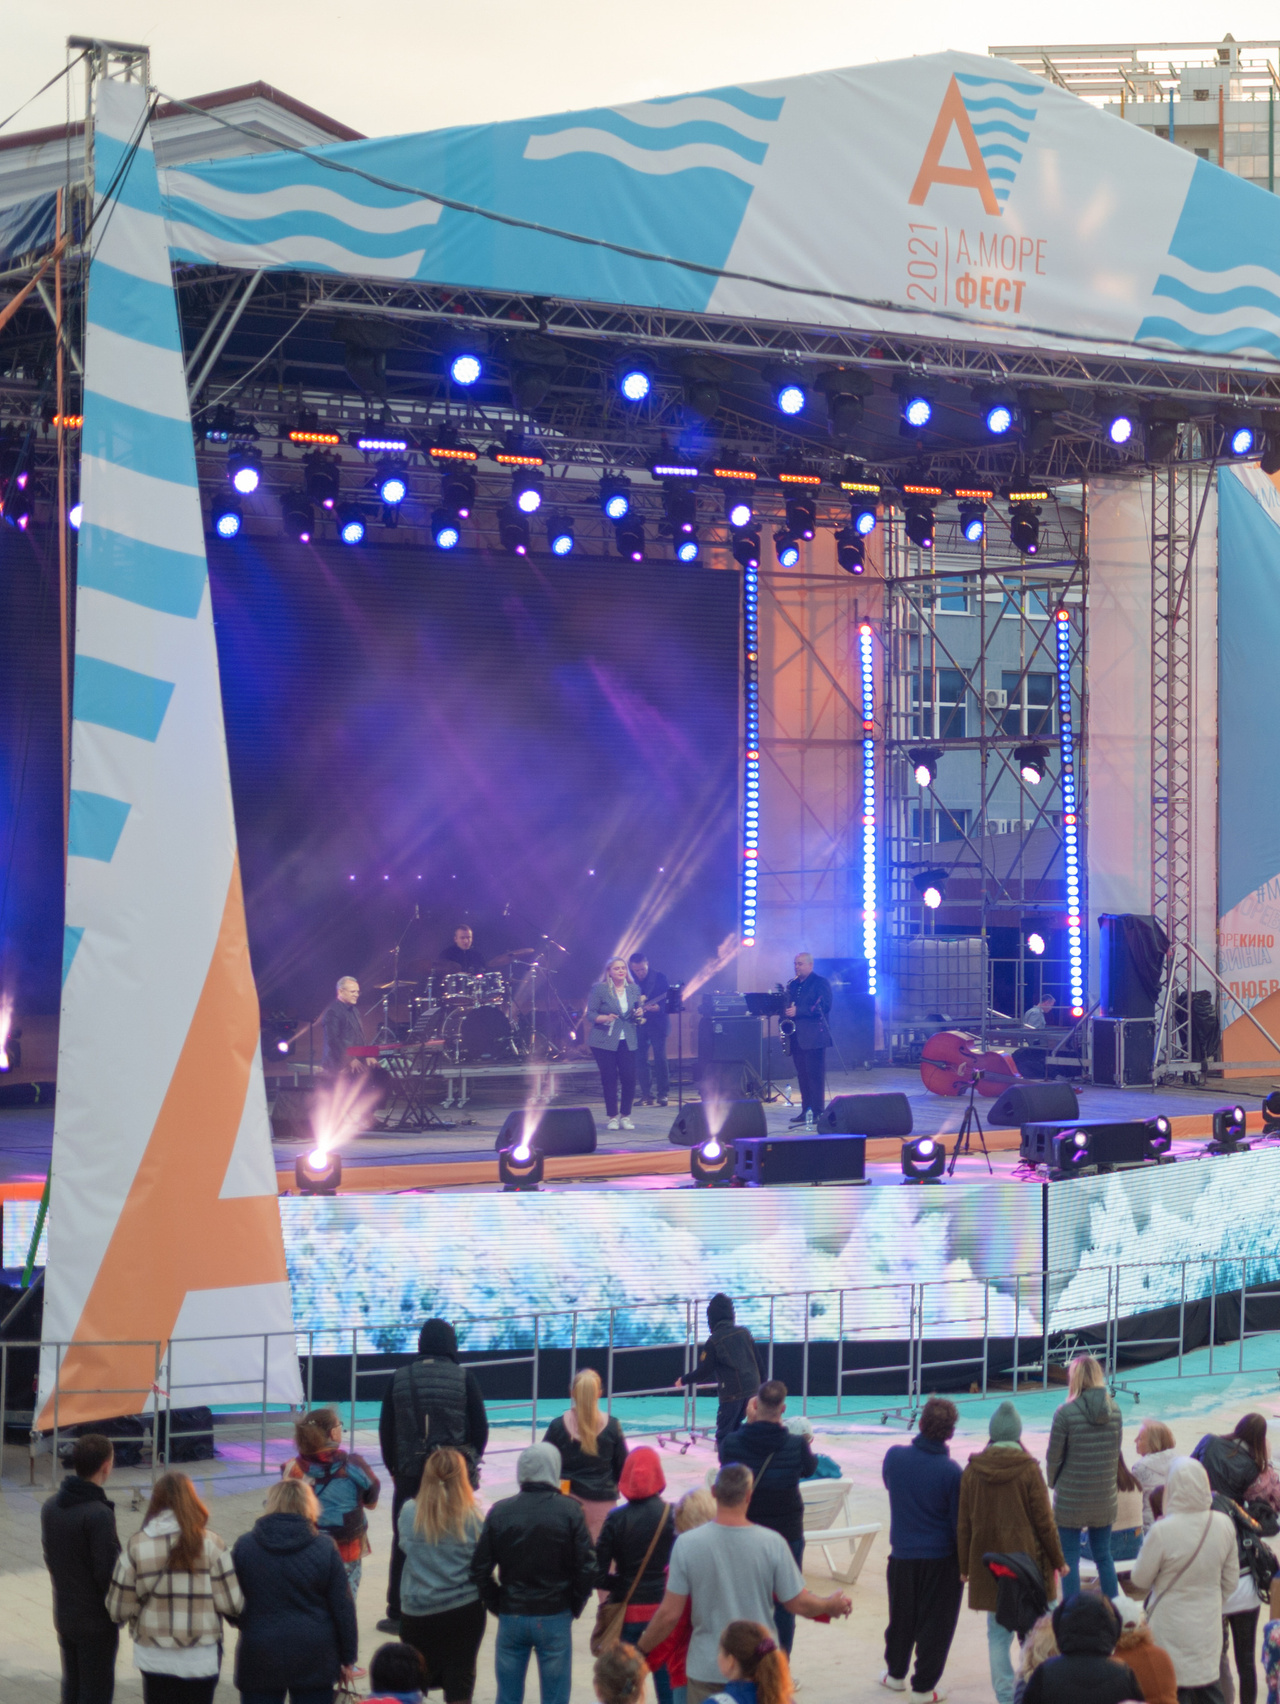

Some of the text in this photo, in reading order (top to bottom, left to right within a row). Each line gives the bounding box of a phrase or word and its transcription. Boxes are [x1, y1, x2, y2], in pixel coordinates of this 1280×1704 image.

[907, 223, 938, 303] 2021
[956, 229, 1047, 275] А.МОРЕ
[955, 272, 1027, 314] ФЕСТ
